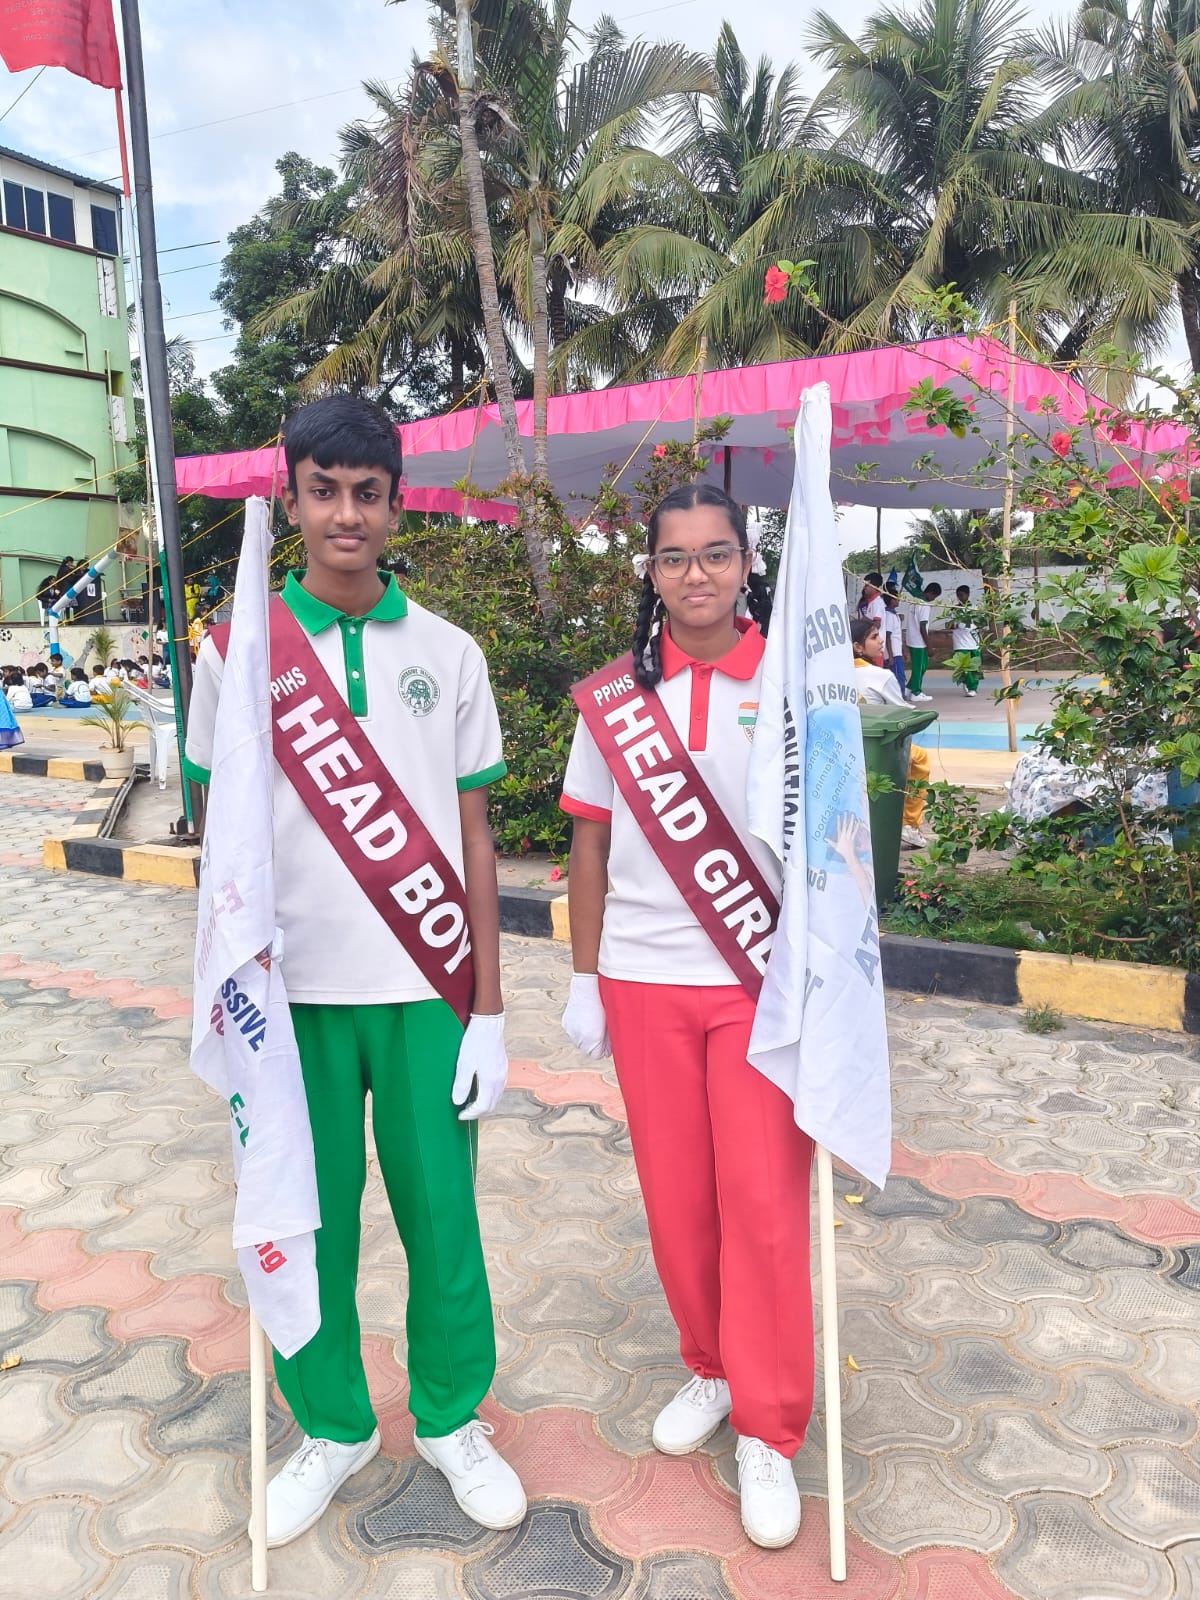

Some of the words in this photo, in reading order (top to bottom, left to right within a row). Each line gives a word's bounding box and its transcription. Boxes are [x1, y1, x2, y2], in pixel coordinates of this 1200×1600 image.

[592, 673, 635, 707] PPIHS
[276, 694, 409, 862] HEAD
[604, 696, 708, 842] HEAD
